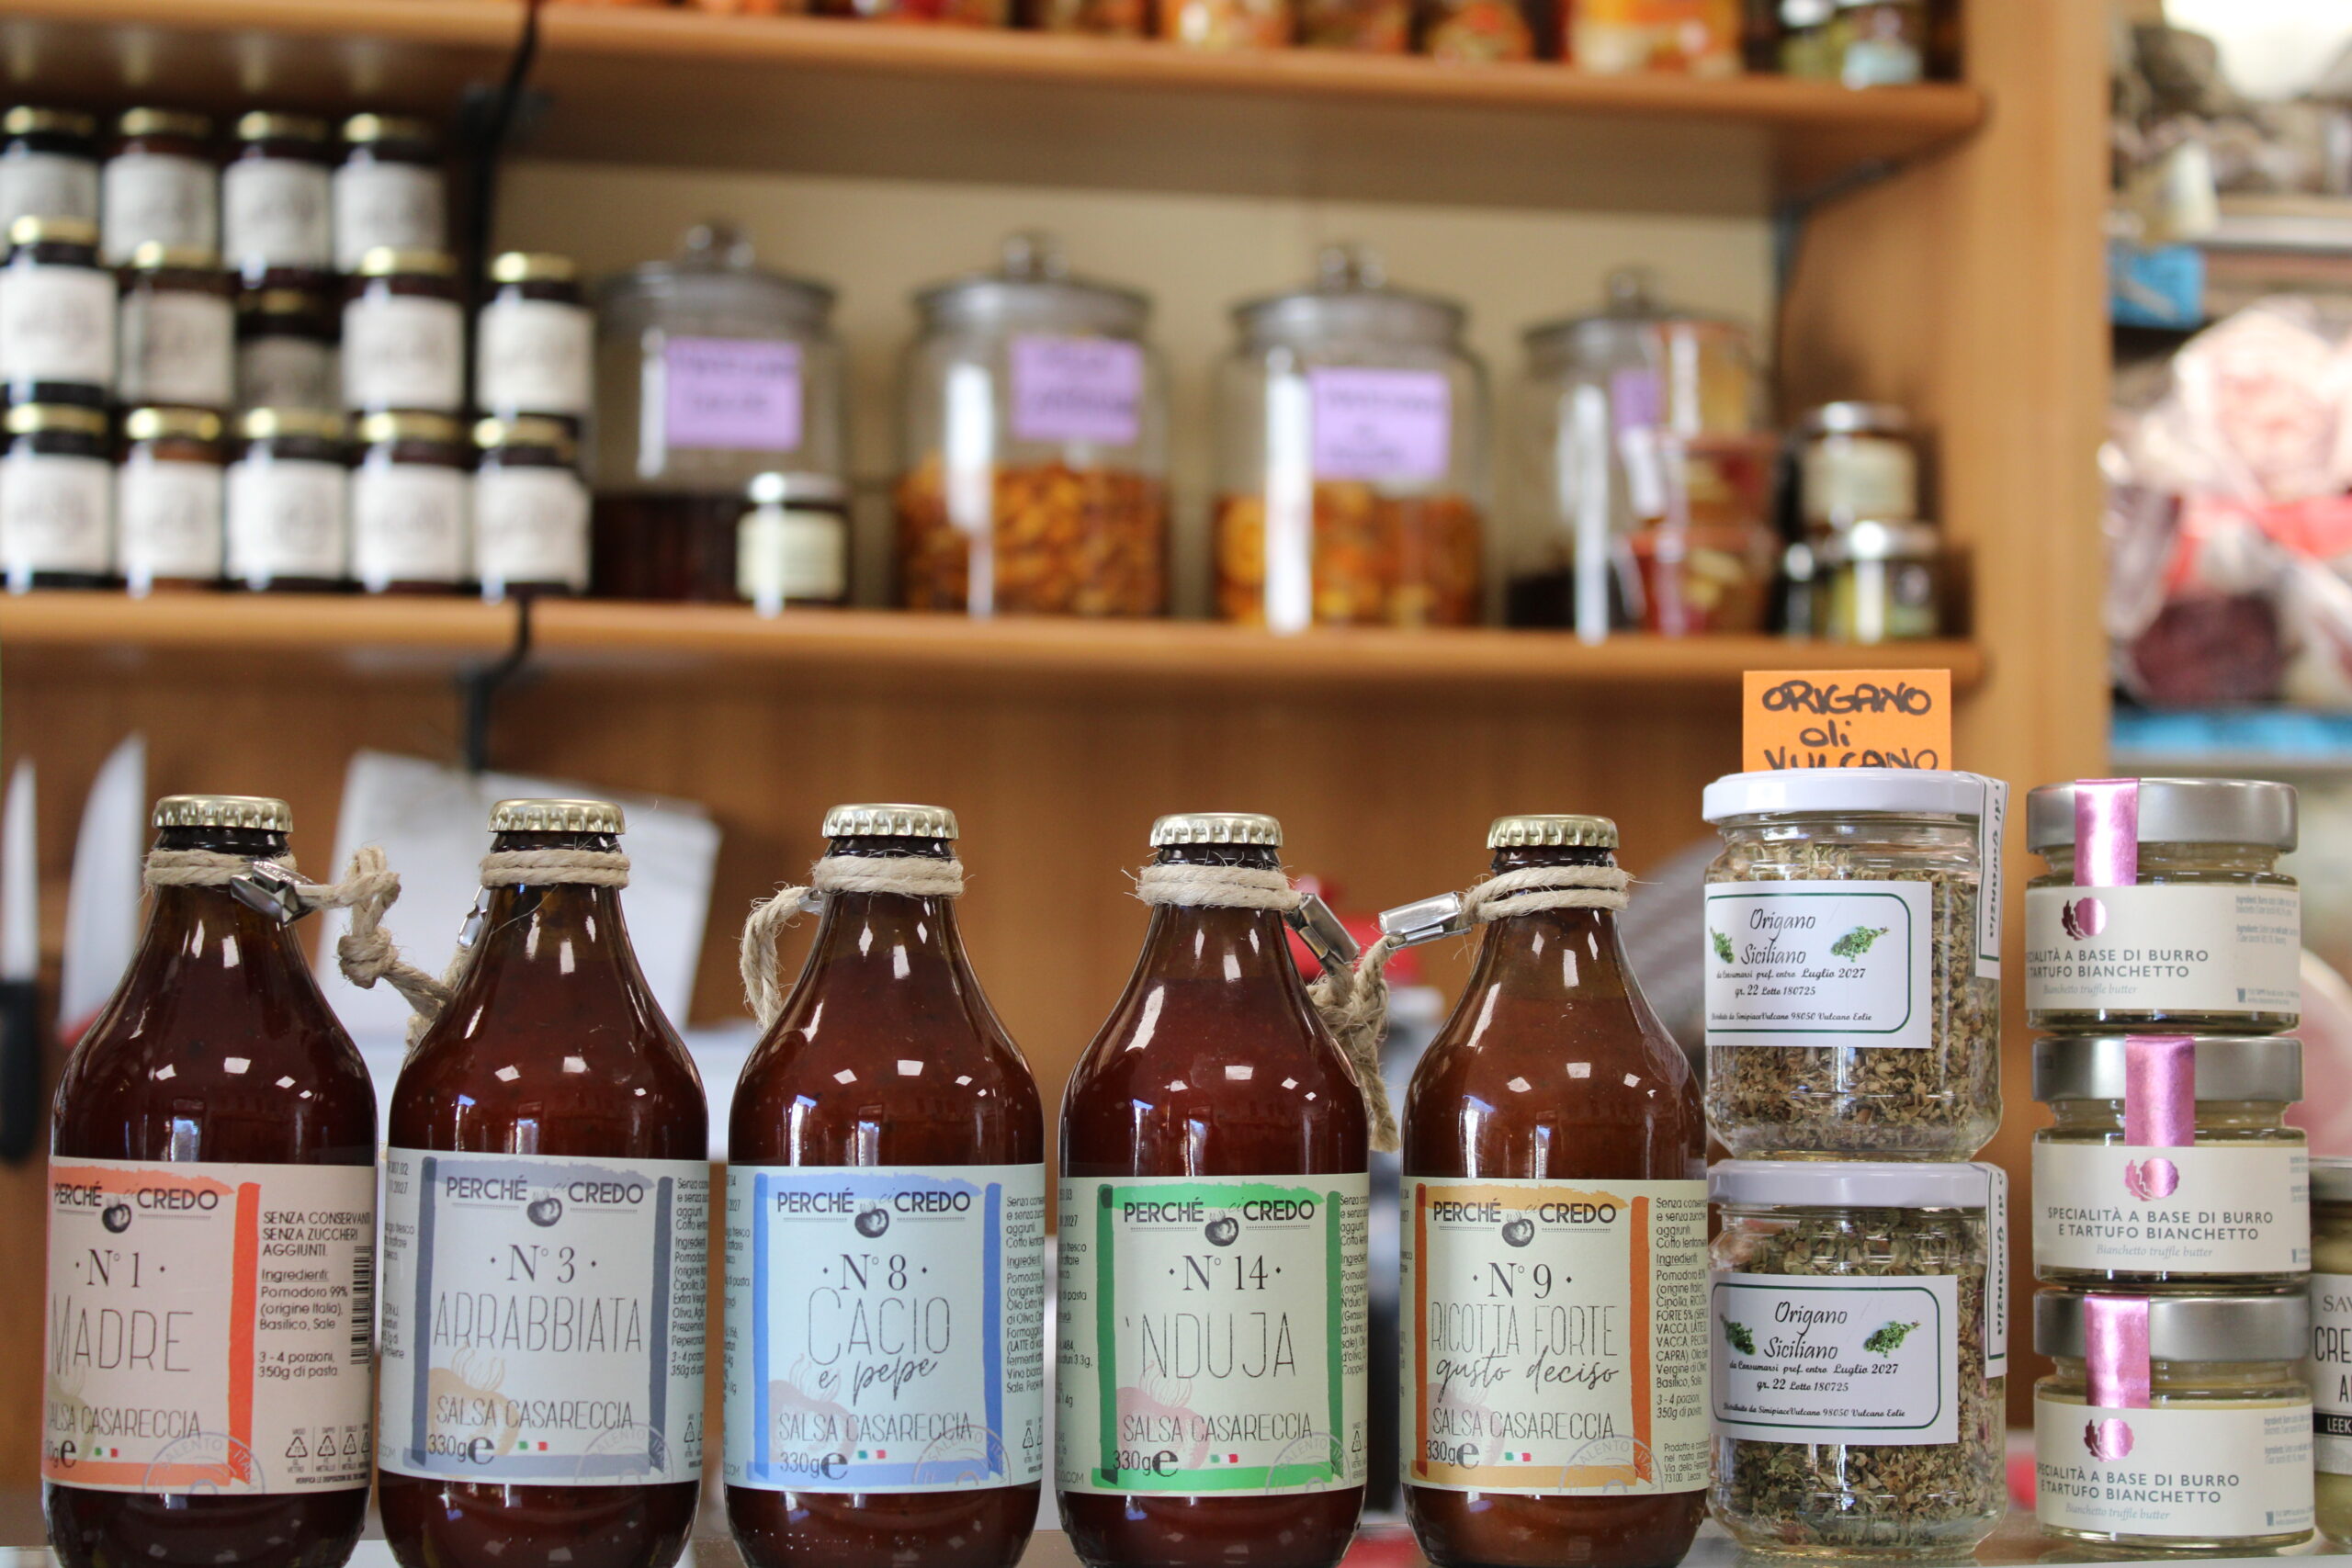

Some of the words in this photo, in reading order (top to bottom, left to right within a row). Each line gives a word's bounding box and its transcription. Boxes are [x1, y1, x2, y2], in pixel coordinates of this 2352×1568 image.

[1762, 680, 1931, 716] ORIGANO
[1750, 908, 1815, 941] Origano
[1740, 939, 1806, 964] Siciliano
[2064, 949, 2073, 962] A
[2078, 949, 2116, 962] BASE
[2123, 949, 2141, 962] DI
[2149, 949, 2209, 962] BURRO
[1801, 967, 1835, 981] Luglio
[1838, 968, 1866, 979] 2027
[2030, 965, 2073, 977] TARTUFO
[2078, 965, 2189, 978] BIANCHETTO
[1747, 984, 1758, 996] 22
[1761, 986, 1781, 997] Lotto
[1783, 986, 1815, 996] 180725
[2080, 984, 2106, 997] truffle
[2109, 984, 2139, 995] butter
[1791, 1012, 1816, 1021] 98050
[1818, 1012, 1850, 1021] Vulcano
[1852, 1012, 1872, 1021] Eolie
[54, 1180, 103, 1207] PERCHÉ
[138, 1188, 219, 1211] CREDO
[447, 1175, 527, 1201] PERCHÉ
[569, 1182, 644, 1204] CREDO
[778, 1189, 854, 1213] PERCHÉ
[895, 1191, 971, 1212] CREDO
[263, 1212, 305, 1225] SENZA
[1125, 1198, 1204, 1223] PERCHÉ
[1243, 1200, 1315, 1220] CREDO
[1433, 1198, 1502, 1224] PERCHÉ
[1539, 1202, 1617, 1224] CREDO
[2048, 1206, 2122, 1223] SPECIALITÀ
[2129, 1211, 2140, 1223] A
[2147, 1211, 2190, 1224] BASE
[2199, 1212, 2215, 1224] DI
[2223, 1212, 2273, 1224] BURRO
[263, 1228, 304, 1241] SENZA
[308, 1228, 358, 1241] ZUCCHERI
[2059, 1224, 2064, 1235] E
[2068, 1224, 2139, 1238] TARTUFO
[2147, 1227, 2258, 1240] BIANCHETTO
[2097, 1244, 2147, 1257] Bianchetto
[2149, 1245, 2180, 1259] truffle
[2183, 1245, 2213, 1257] butter
[557, 1247, 575, 1283] 3
[888, 1254, 907, 1291] 8
[1234, 1255, 1268, 1291] 14
[261, 1286, 327, 1298] Pomodoro
[330, 1286, 348, 1297] 99%
[1532, 1263, 1553, 1300] 9
[313, 1318, 335, 1329] Sale
[433, 1291, 642, 1353] ARRABBIATA
[808, 1287, 951, 1366] CACIO
[1431, 1302, 1521, 1356] RICOTTA
[1534, 1304, 1618, 1357] FORTE
[1774, 1301, 1848, 1335] Origano
[51, 1293, 194, 1377] MADRE
[1764, 1335, 1838, 1359] Siciliano
[259, 1351, 266, 1363] 3
[277, 1351, 285, 1363] 4
[258, 1366, 290, 1380] 350g
[293, 1365, 306, 1378] di
[308, 1366, 338, 1380] pasta
[819, 1369, 838, 1389] e
[853, 1357, 939, 1407] pepe
[1435, 1346, 1513, 1404] gusto
[1526, 1345, 1619, 1395] deciso
[1805, 1365, 1827, 1374] entro
[1833, 1363, 1868, 1377] Luglio
[1871, 1363, 1899, 1375] 2027
[1772, 1379, 1786, 1390] 22
[1789, 1381, 1811, 1392] Lotto
[1814, 1382, 1849, 1392] 180725
[81, 1405, 201, 1439] CASARECCIA
[436, 1395, 497, 1427] SALSA
[505, 1400, 633, 1429] CASARECCIA
[1432, 1407, 1484, 1438] SALSA
[1490, 1411, 1614, 1440] CASARECCIA
[1823, 1408, 1849, 1417] 98050
[1851, 1408, 1884, 1417] Vulcano
[1886, 1409, 1905, 1417] Eolie
[779, 1412, 838, 1442] SALSA
[846, 1412, 972, 1442] CASARECCIA
[1123, 1414, 1183, 1442] SALSA
[1192, 1412, 1312, 1442] CASARECCIA
[2327, 1417, 2352, 1433] LEEK
[2036, 1462, 2086, 1481] PECIALITÀ
[2091, 1471, 2100, 1483] A
[2107, 1472, 2146, 1485] BASE
[2154, 1473, 2172, 1486] DI
[2181, 1474, 2239, 1486] BURRO
[2046, 1480, 2099, 1499] TARTUFO
[2107, 1488, 2221, 1503] BIANCHETTO
[2109, 1506, 2138, 1521] truffle
[2140, 1506, 2170, 1519] butter
